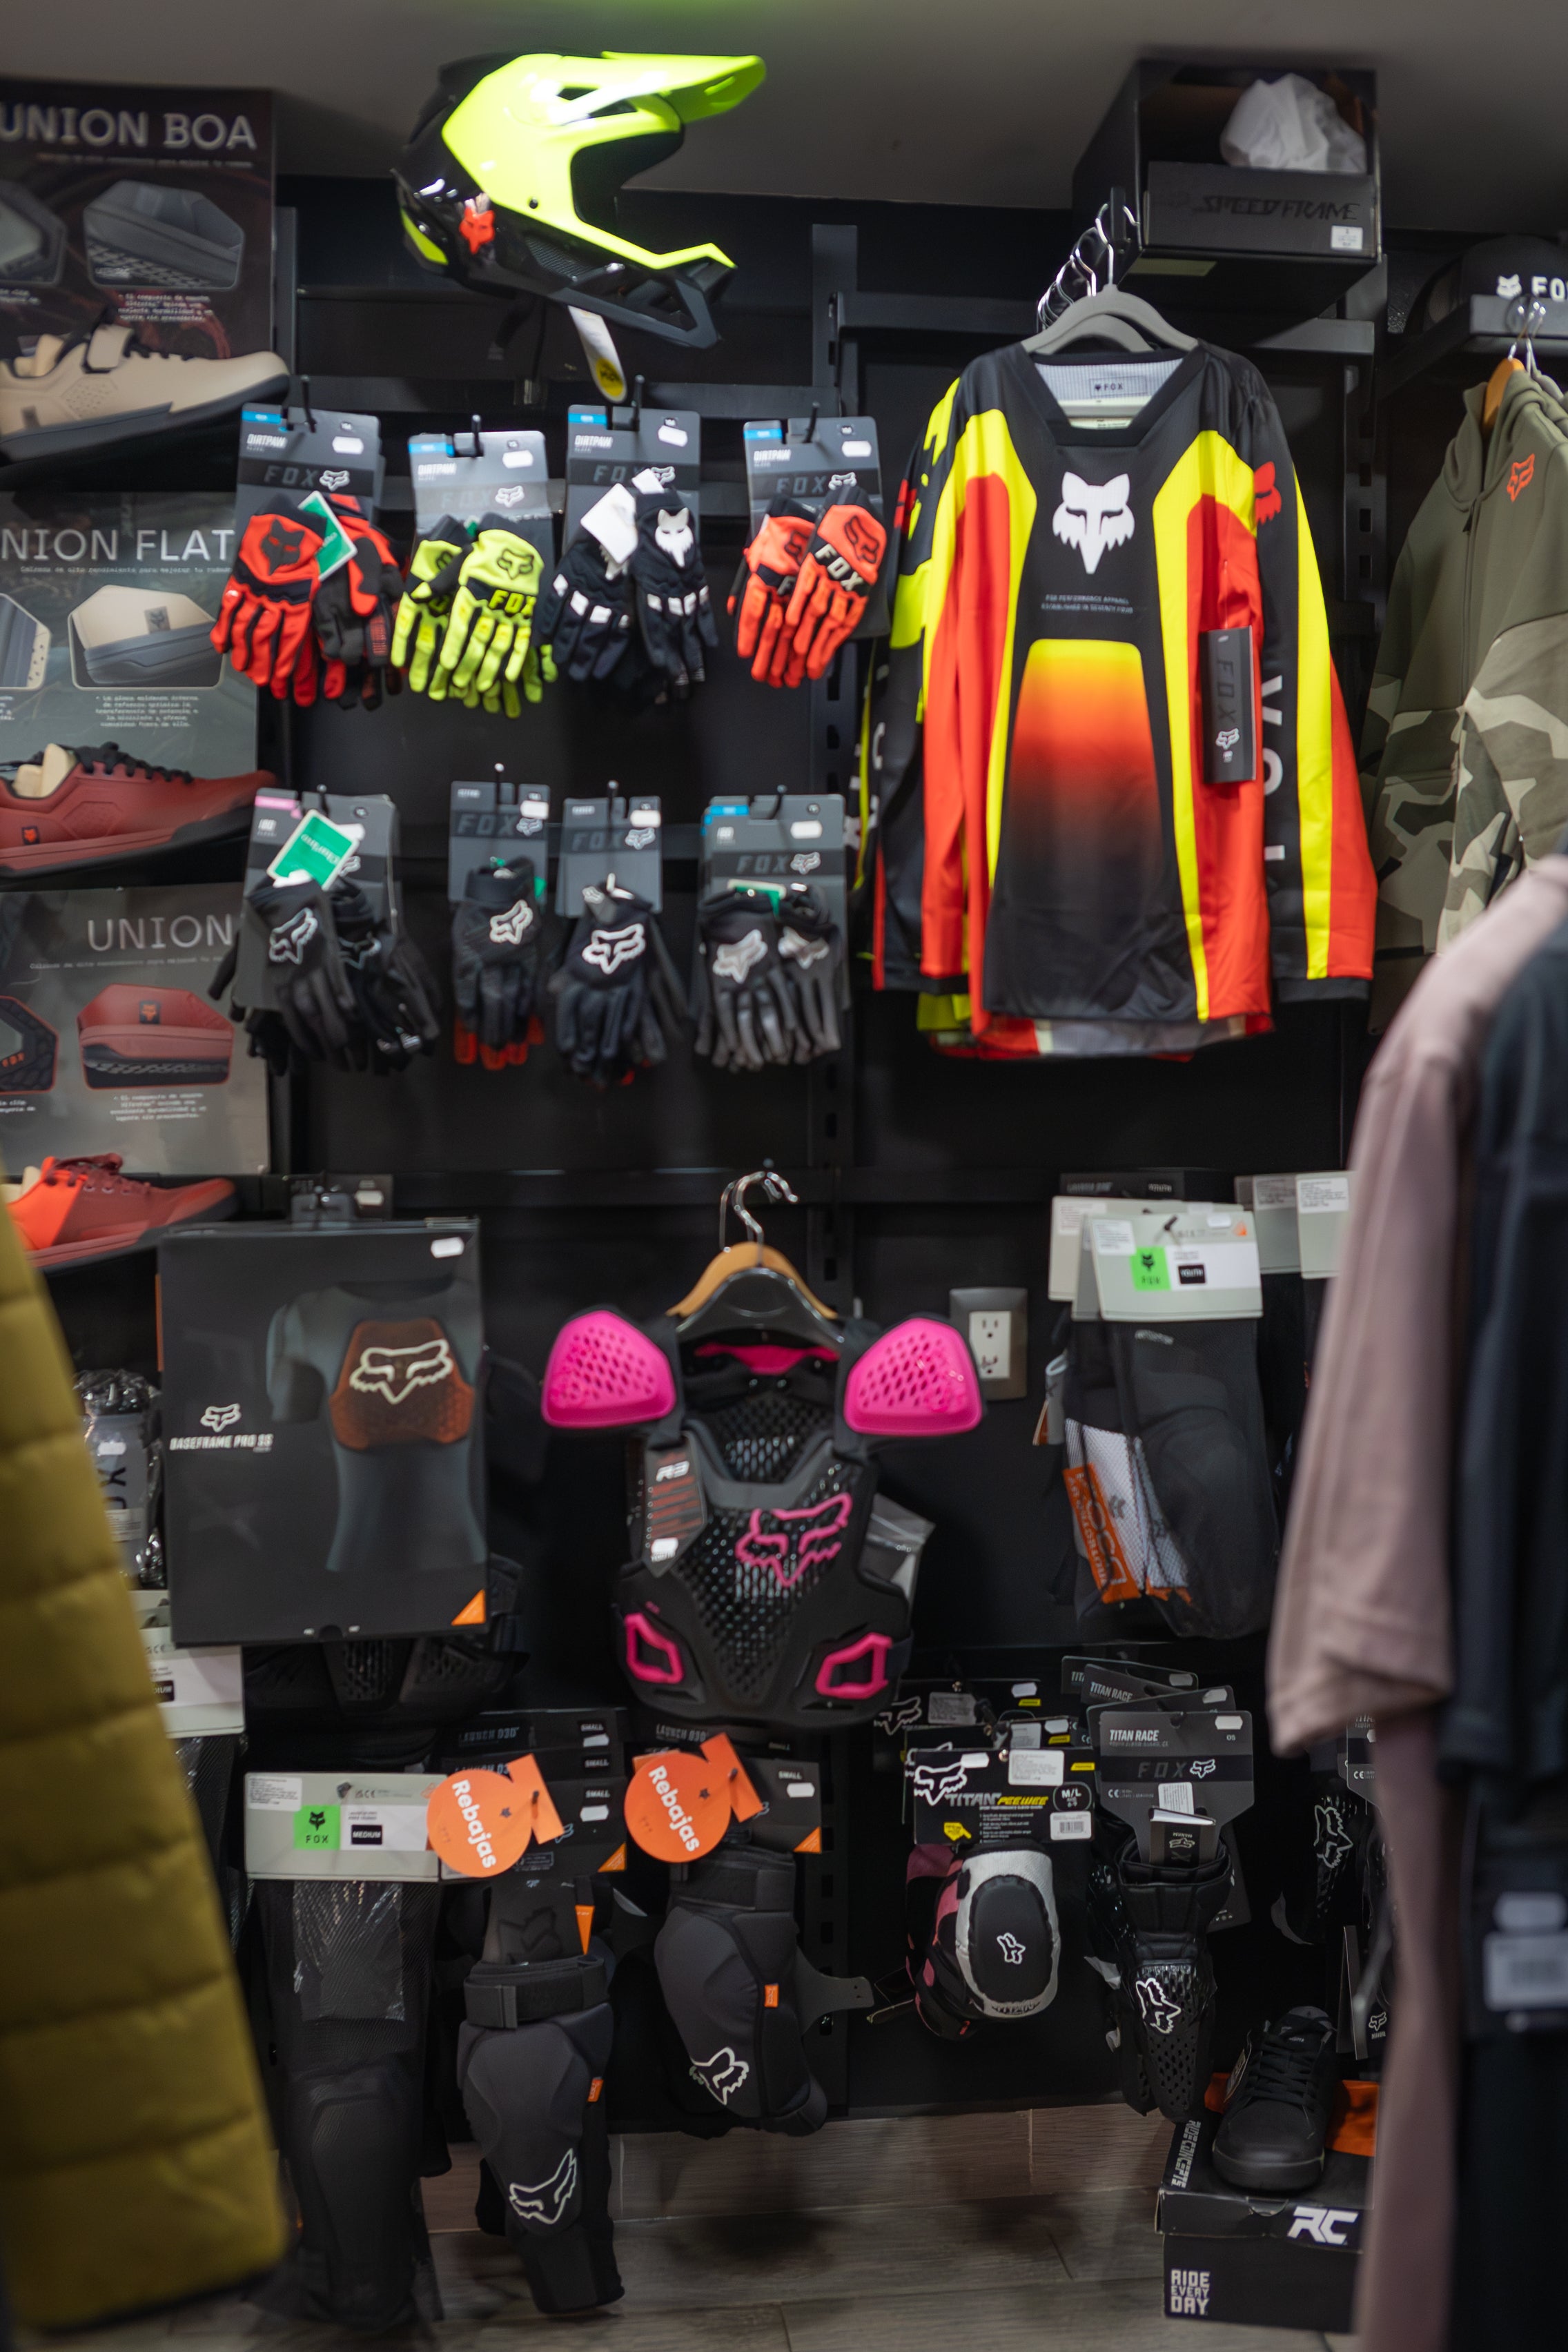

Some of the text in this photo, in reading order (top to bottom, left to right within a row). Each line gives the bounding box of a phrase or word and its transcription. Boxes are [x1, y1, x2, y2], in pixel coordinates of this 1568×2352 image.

[0, 104, 256, 150] UNION BOA
[1531, 275, 1568, 302] FO
[1104, 382, 1123, 391] FOX
[247, 433, 288, 449] DIRTPAW
[264, 466, 319, 487] FOX
[776, 476, 827, 494] FOX
[0, 529, 235, 561] NION FLAT
[815, 544, 863, 591] FOX
[488, 589, 536, 616] FOX
[1217, 658, 1236, 723] FOX
[458, 813, 517, 836] FOX
[736, 855, 790, 874] FOX
[88, 914, 232, 951] UNION
[170, 1435, 233, 1451] BASEFRAME
[233, 1434, 257, 1448] PRO
[656, 1460, 689, 1482] R3
[1090, 1681, 1133, 1703] TITAN RACE
[1110, 1729, 1159, 1741] TITAN RACE
[585, 1760, 609, 1768] SMALL
[1137, 1762, 1187, 1778] FOX
[778, 1770, 803, 1780] SMALL
[586, 1790, 610, 1799] SMALL
[945, 1792, 1048, 1807] TITAN PEEWEE
[1061, 1788, 1081, 1799] M/L
[649, 1765, 700, 1852] Rebajas
[452, 1780, 496, 1868] Rebajas
[306, 1834, 329, 1844] FOX
[353, 1831, 381, 1839] MEDIUM
[1288, 2206, 1358, 2245] RC
[1171, 2269, 1211, 2289] RIDE
[1171, 2285, 1209, 2299] EVERY
[1171, 2295, 1210, 2315] DAY
